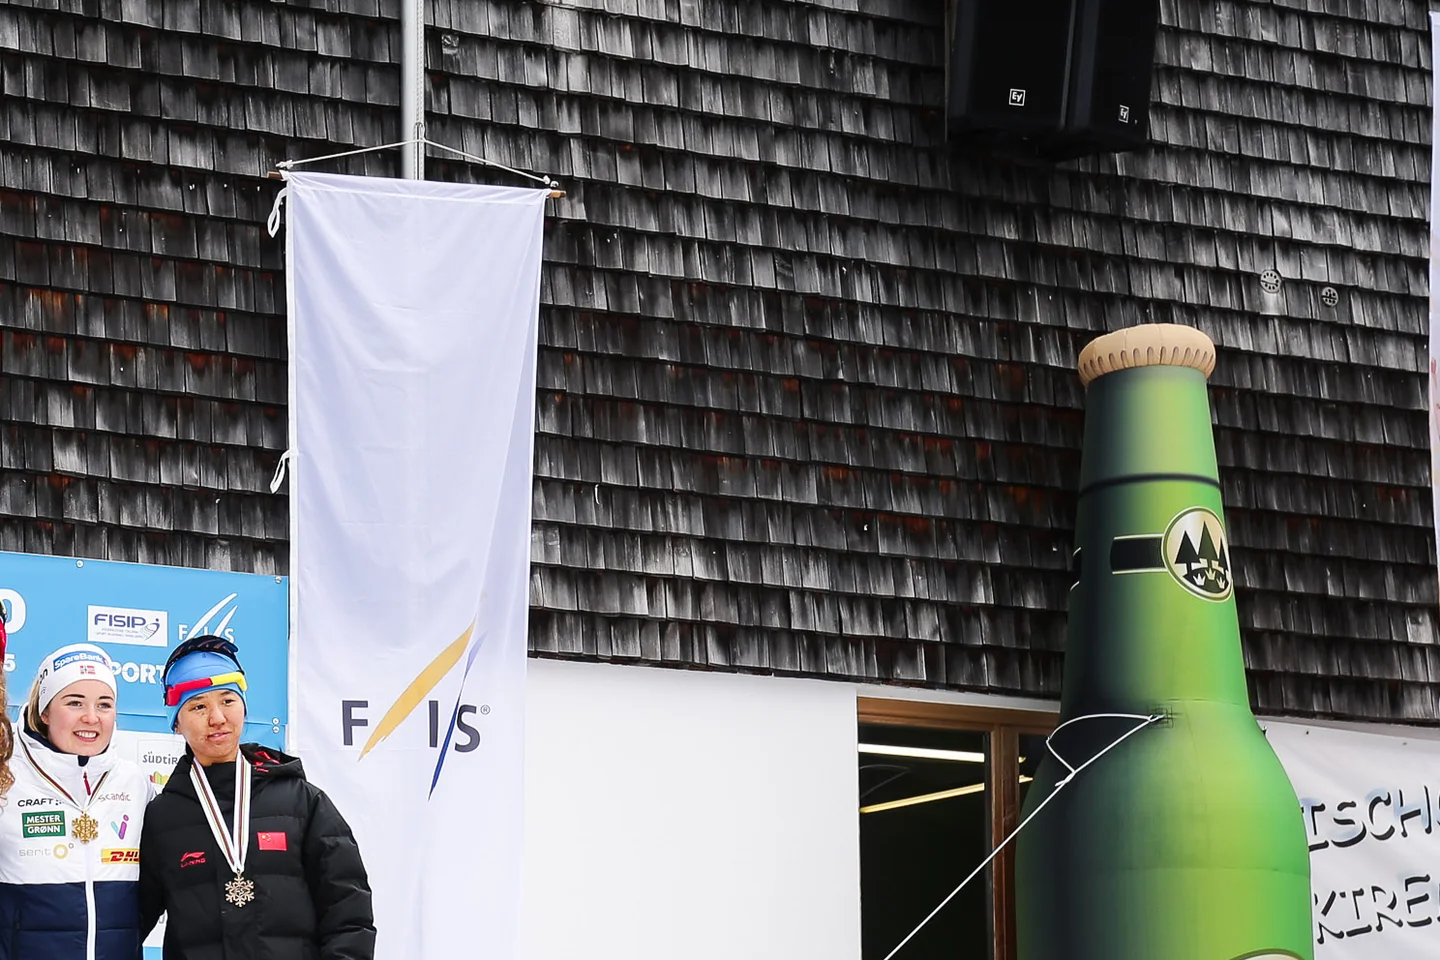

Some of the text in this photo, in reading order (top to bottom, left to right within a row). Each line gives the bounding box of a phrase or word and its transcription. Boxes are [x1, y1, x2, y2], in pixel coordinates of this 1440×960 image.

[94, 613, 147, 629] FISIP
[54, 652, 103, 669] SpareBank
[17, 798, 54, 807] CRAFT
[26, 814, 61, 824] MESTER
[27, 825, 61, 834] GRØNN
